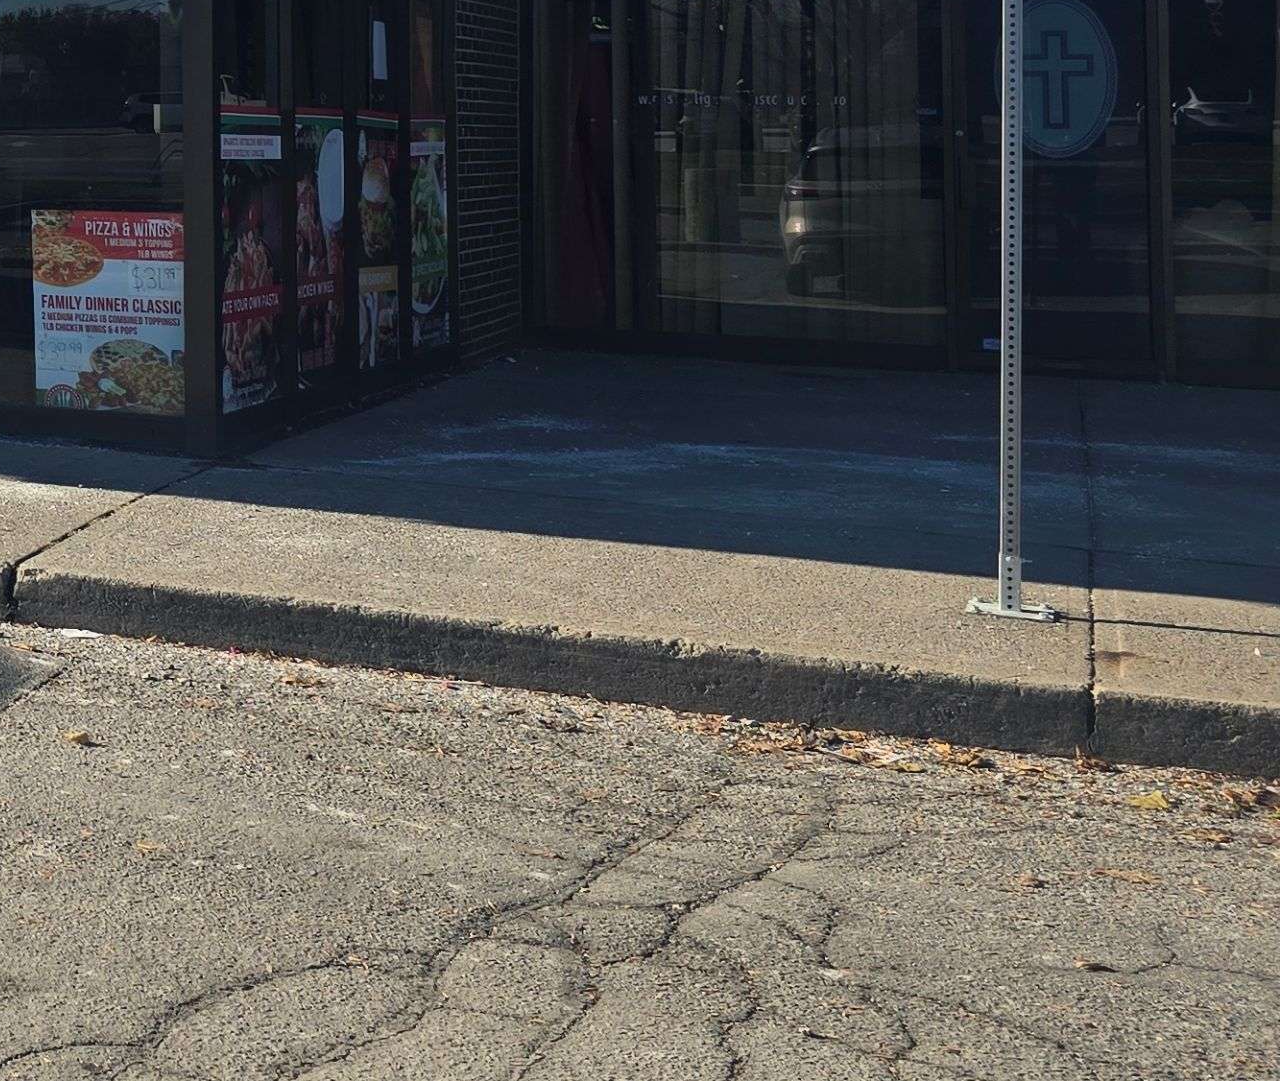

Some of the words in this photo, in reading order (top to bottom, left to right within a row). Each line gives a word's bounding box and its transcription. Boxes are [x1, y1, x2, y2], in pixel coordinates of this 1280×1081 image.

[85, 221, 119, 236] PIZZA
[122, 221, 130, 235] &
[133, 221, 173, 237] WINGS
[144, 238, 174, 248] TOPPING
[41, 294, 82, 310] FAMILY
[85, 296, 129, 312] DINNER
[132, 299, 182, 314] CLASSIC
[41, 312, 46, 320] 2
[74, 313, 98, 322] PIZZAS
[55, 323, 84, 332] CHICKEN
[120, 326, 138, 335] POPS
